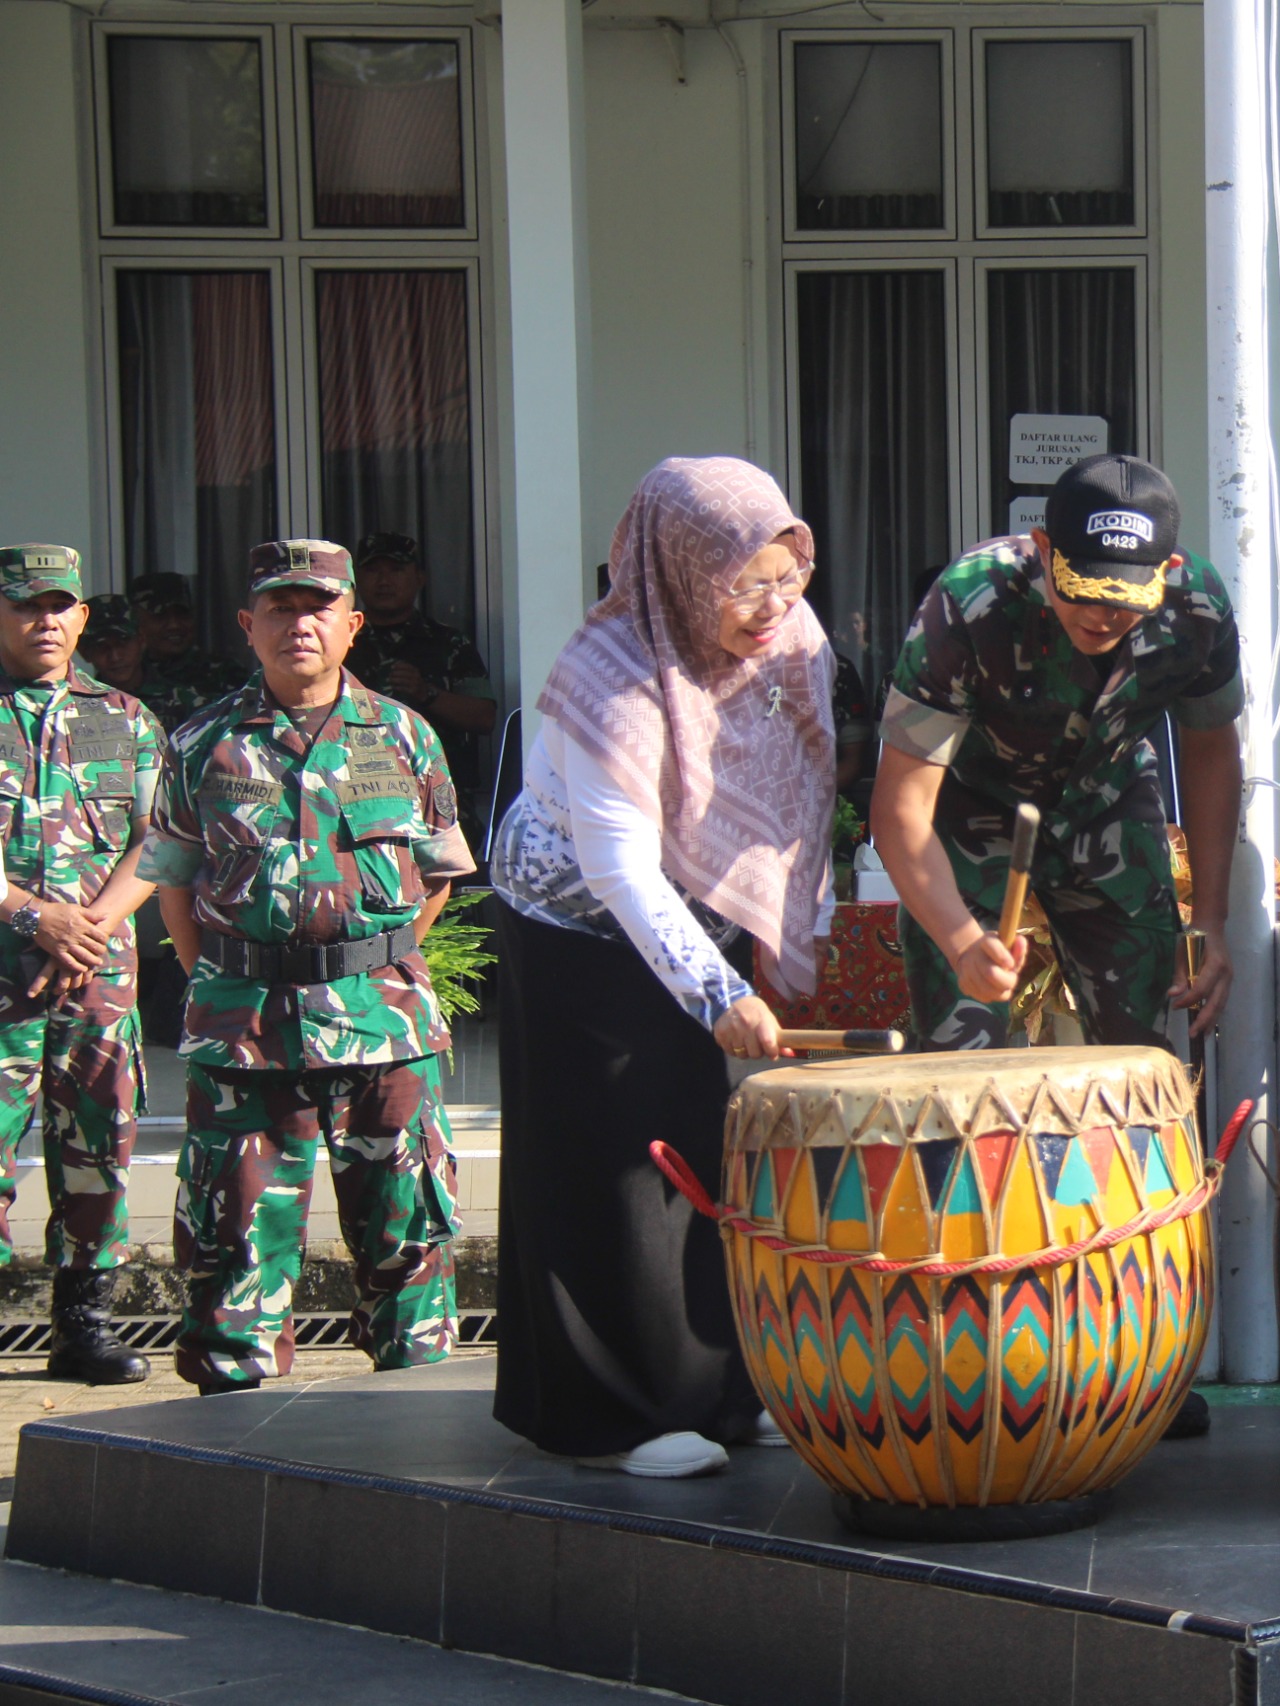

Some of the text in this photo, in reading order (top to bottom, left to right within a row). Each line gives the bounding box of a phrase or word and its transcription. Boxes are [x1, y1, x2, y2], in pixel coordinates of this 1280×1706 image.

[1020, 433, 1098, 443] DAFTAR ULANG
[1036, 444, 1081, 454] JURUSAN
[1014, 455, 1038, 466] TKJ,
[1040, 456, 1063, 465] TKP
[1093, 515, 1149, 536] KODIM
[1101, 533, 1139, 550] 0423
[75, 742, 134, 759] TNI AD
[217, 778, 273, 799] HARMIDI
[347, 780, 411, 796] TNI AD
